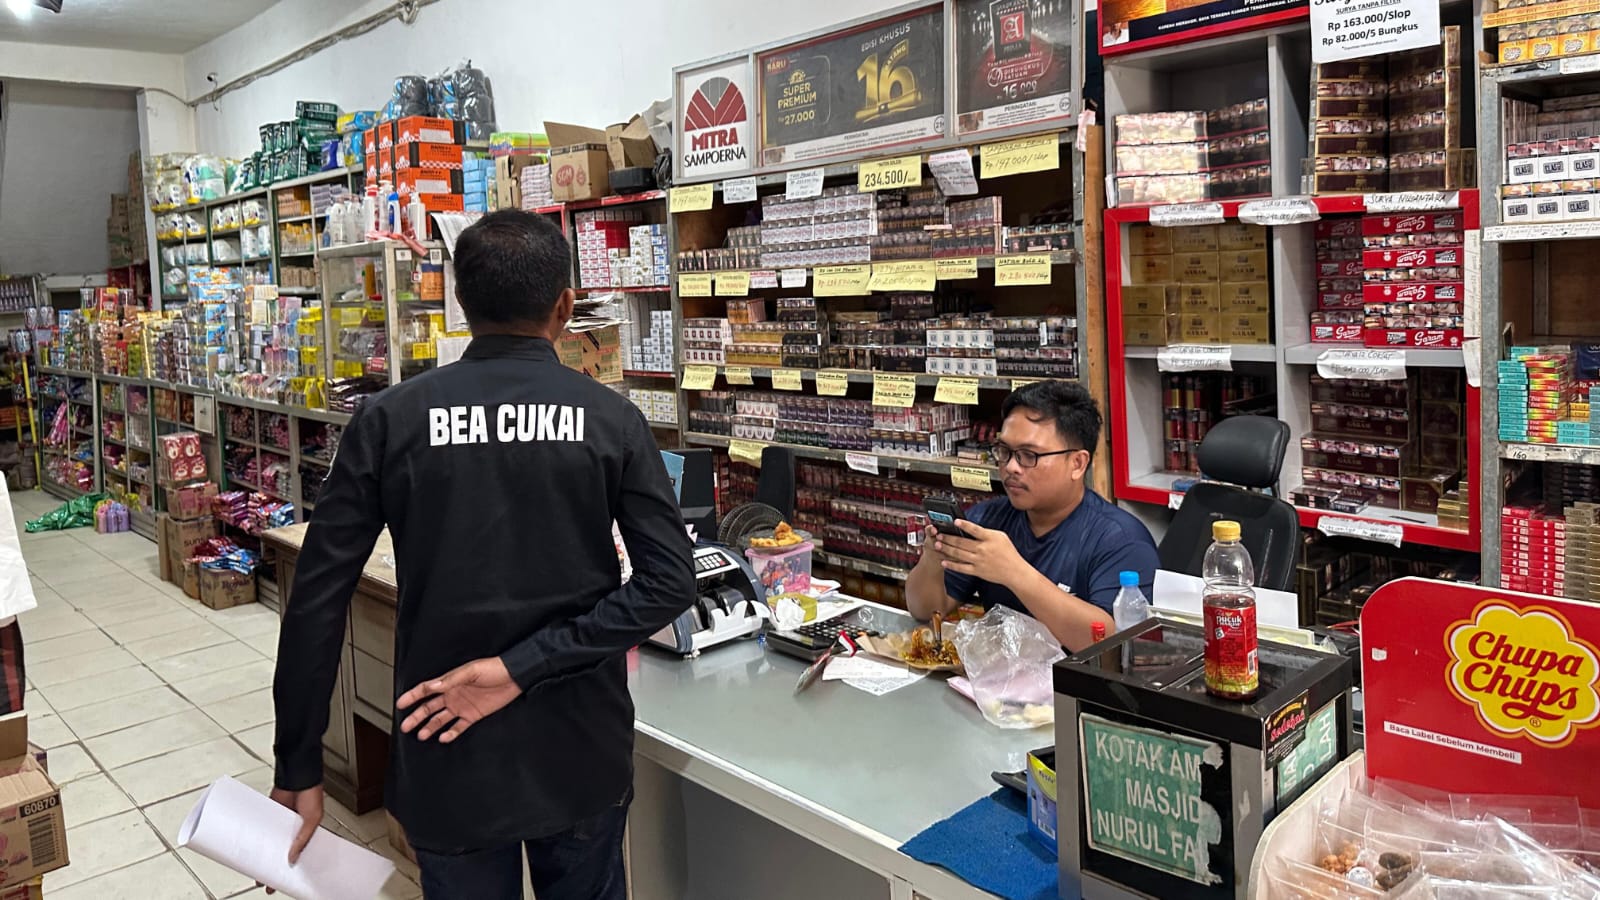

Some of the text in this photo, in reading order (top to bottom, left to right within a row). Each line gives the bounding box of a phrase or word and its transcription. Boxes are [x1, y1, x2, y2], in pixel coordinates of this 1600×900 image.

[1336, 5, 1357, 15] SURYA
[1358, 0, 1379, 10] TANPA
[1328, 9, 1411, 31] Rp 163.000/Slop
[861, 23, 911, 52] EDISI KHUSUS
[1322, 38, 1334, 46] Rp
[1335, 29, 1376, 43] 82.000/5
[1378, 23, 1418, 36] Bungkus
[856, 37, 918, 110] 16
[777, 91, 816, 109] PREMIUM
[783, 83, 811, 97] SUPER
[692, 128, 738, 151] MITRA
[684, 146, 747, 168] SAMPOERNA
[1336, 326, 1361, 340] Garam
[1415, 331, 1444, 346] Garam
[429, 404, 585, 446] BEA CUKAI
[1468, 631, 1584, 677] Chupa
[1463, 662, 1579, 721] Chups
[1095, 731, 1165, 774] KOTAK
[1389, 723, 1516, 760] Baca Label Sebelum Membeli
[24, 796, 56, 816] 60870
[1126, 777, 1201, 824] MASJID
[1096, 808, 1167, 856] NURUL
